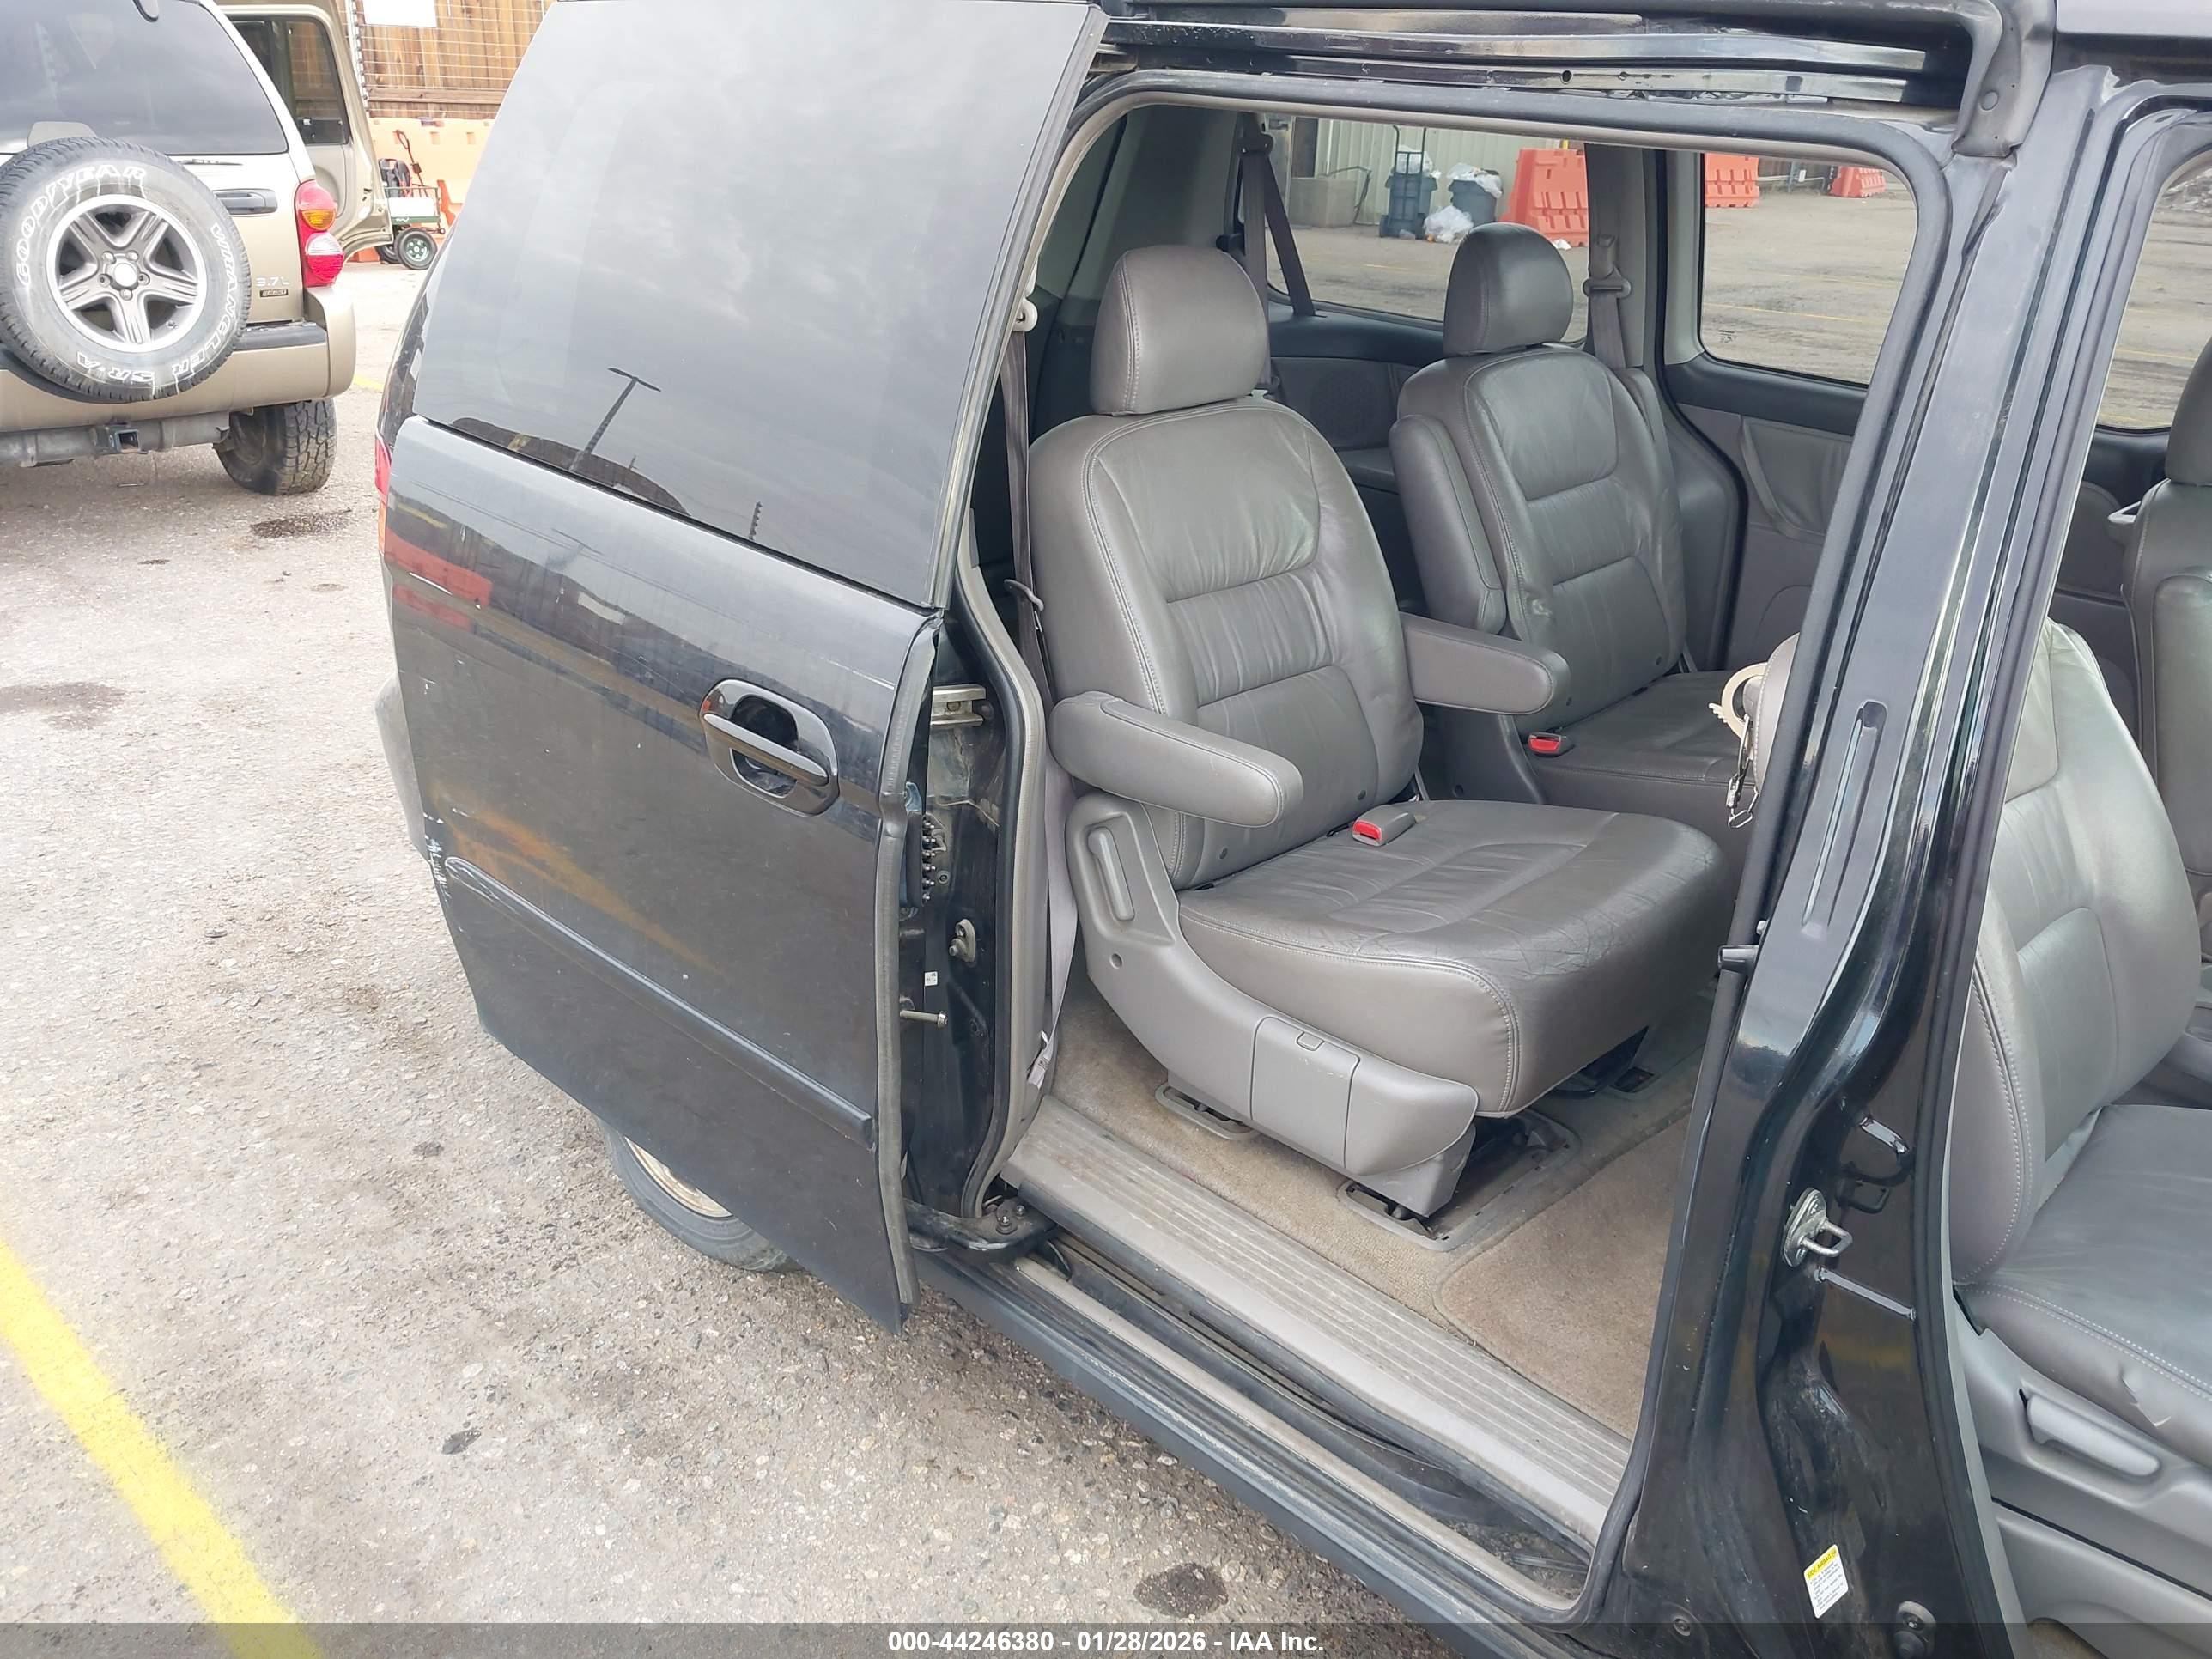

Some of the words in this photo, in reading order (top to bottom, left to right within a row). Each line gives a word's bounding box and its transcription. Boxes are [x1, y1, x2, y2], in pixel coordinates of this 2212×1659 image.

[17, 164, 146, 287] GOODYEAR
[256, 276, 290, 287] 3.7L
[173, 222, 238, 378] WRANGLER
